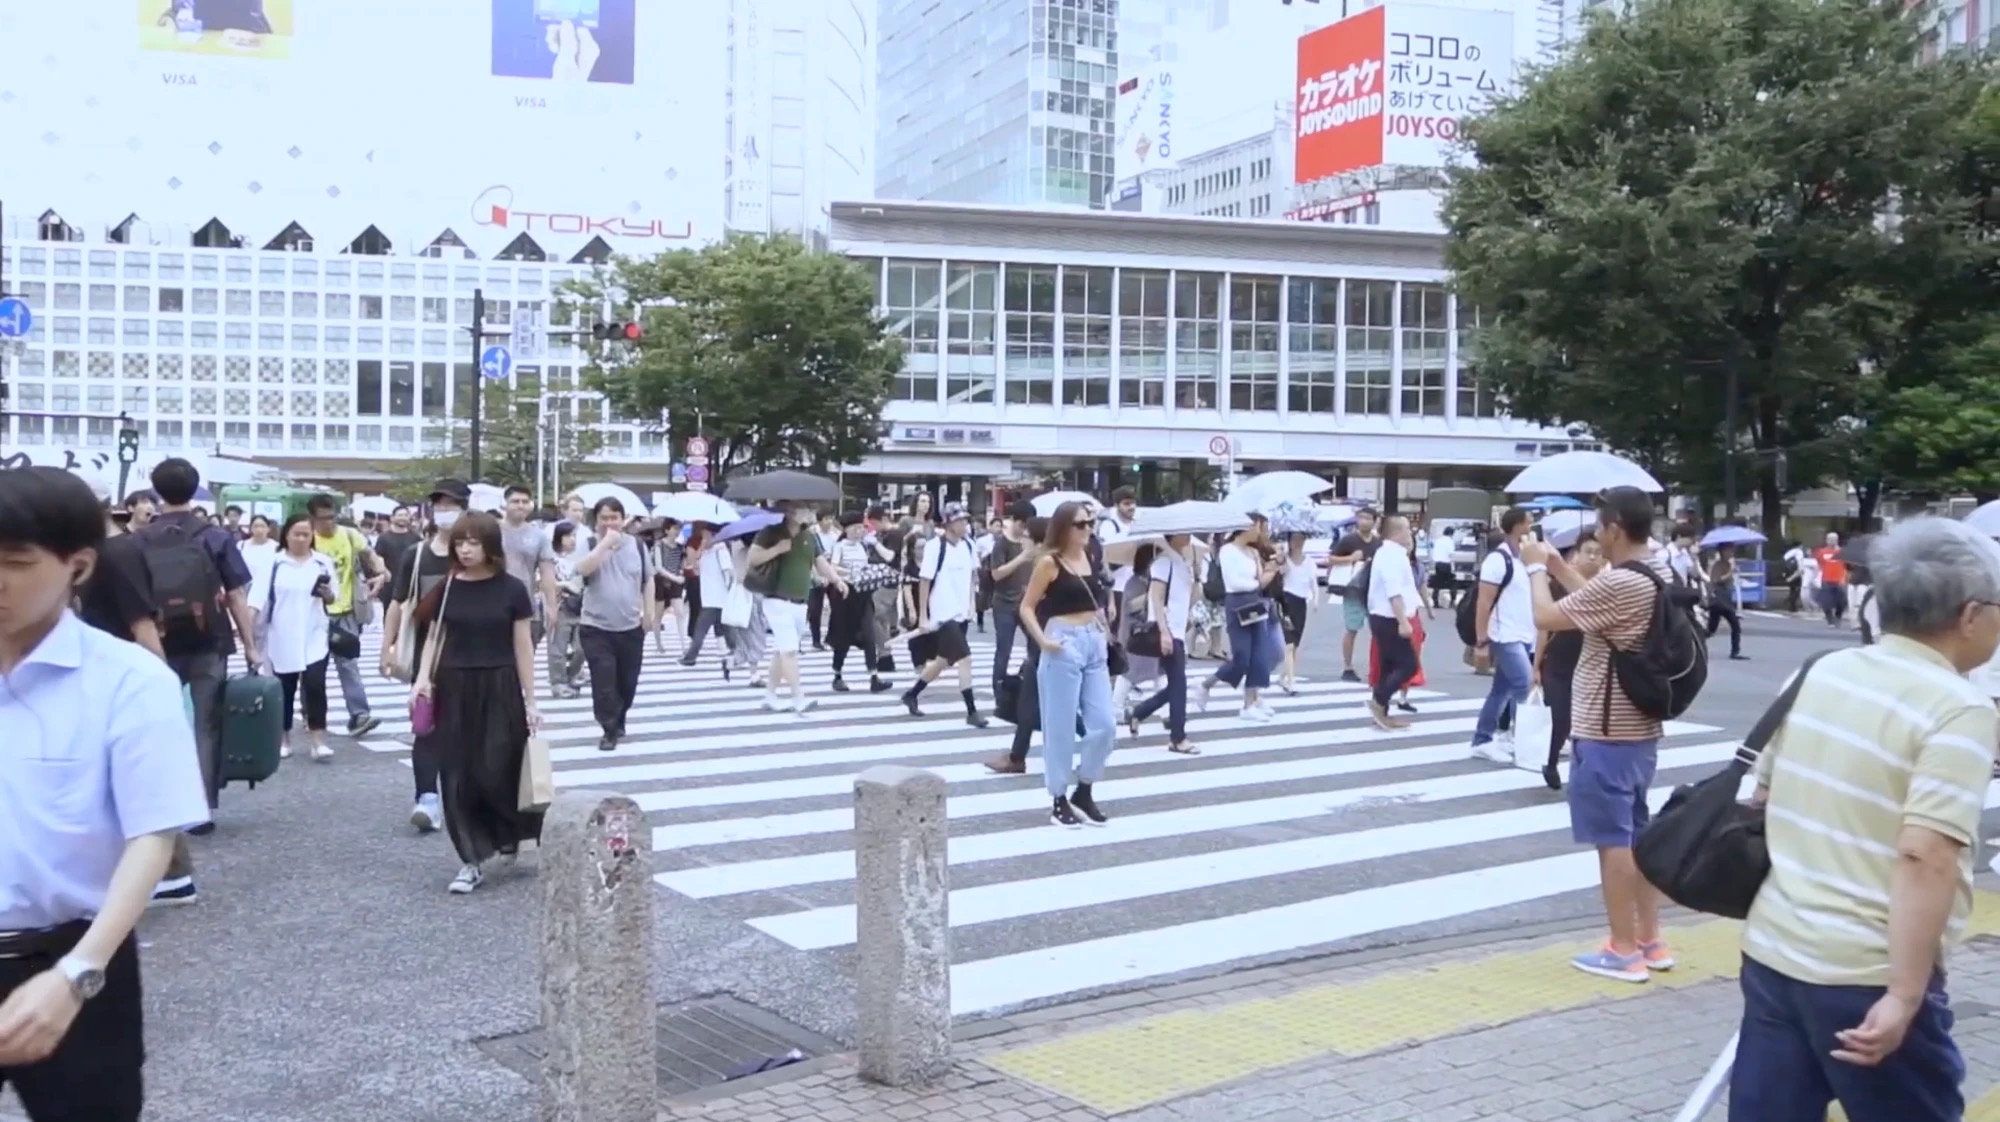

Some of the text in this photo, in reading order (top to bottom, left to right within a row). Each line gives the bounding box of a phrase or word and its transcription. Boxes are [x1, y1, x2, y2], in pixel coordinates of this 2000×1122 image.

[1390, 32, 1481, 61] ココロの
[162, 72, 198, 86] VISA
[1299, 58, 1381, 113] カラオケ
[514, 95, 547, 108] VISA
[1159, 72, 1174, 158] SANKYO
[1298, 92, 1382, 138] JOYSOUND
[1389, 90, 1496, 114] あげていこ
[1386, 114, 1461, 142] JOYSO
[511, 211, 691, 240] TOKYU
